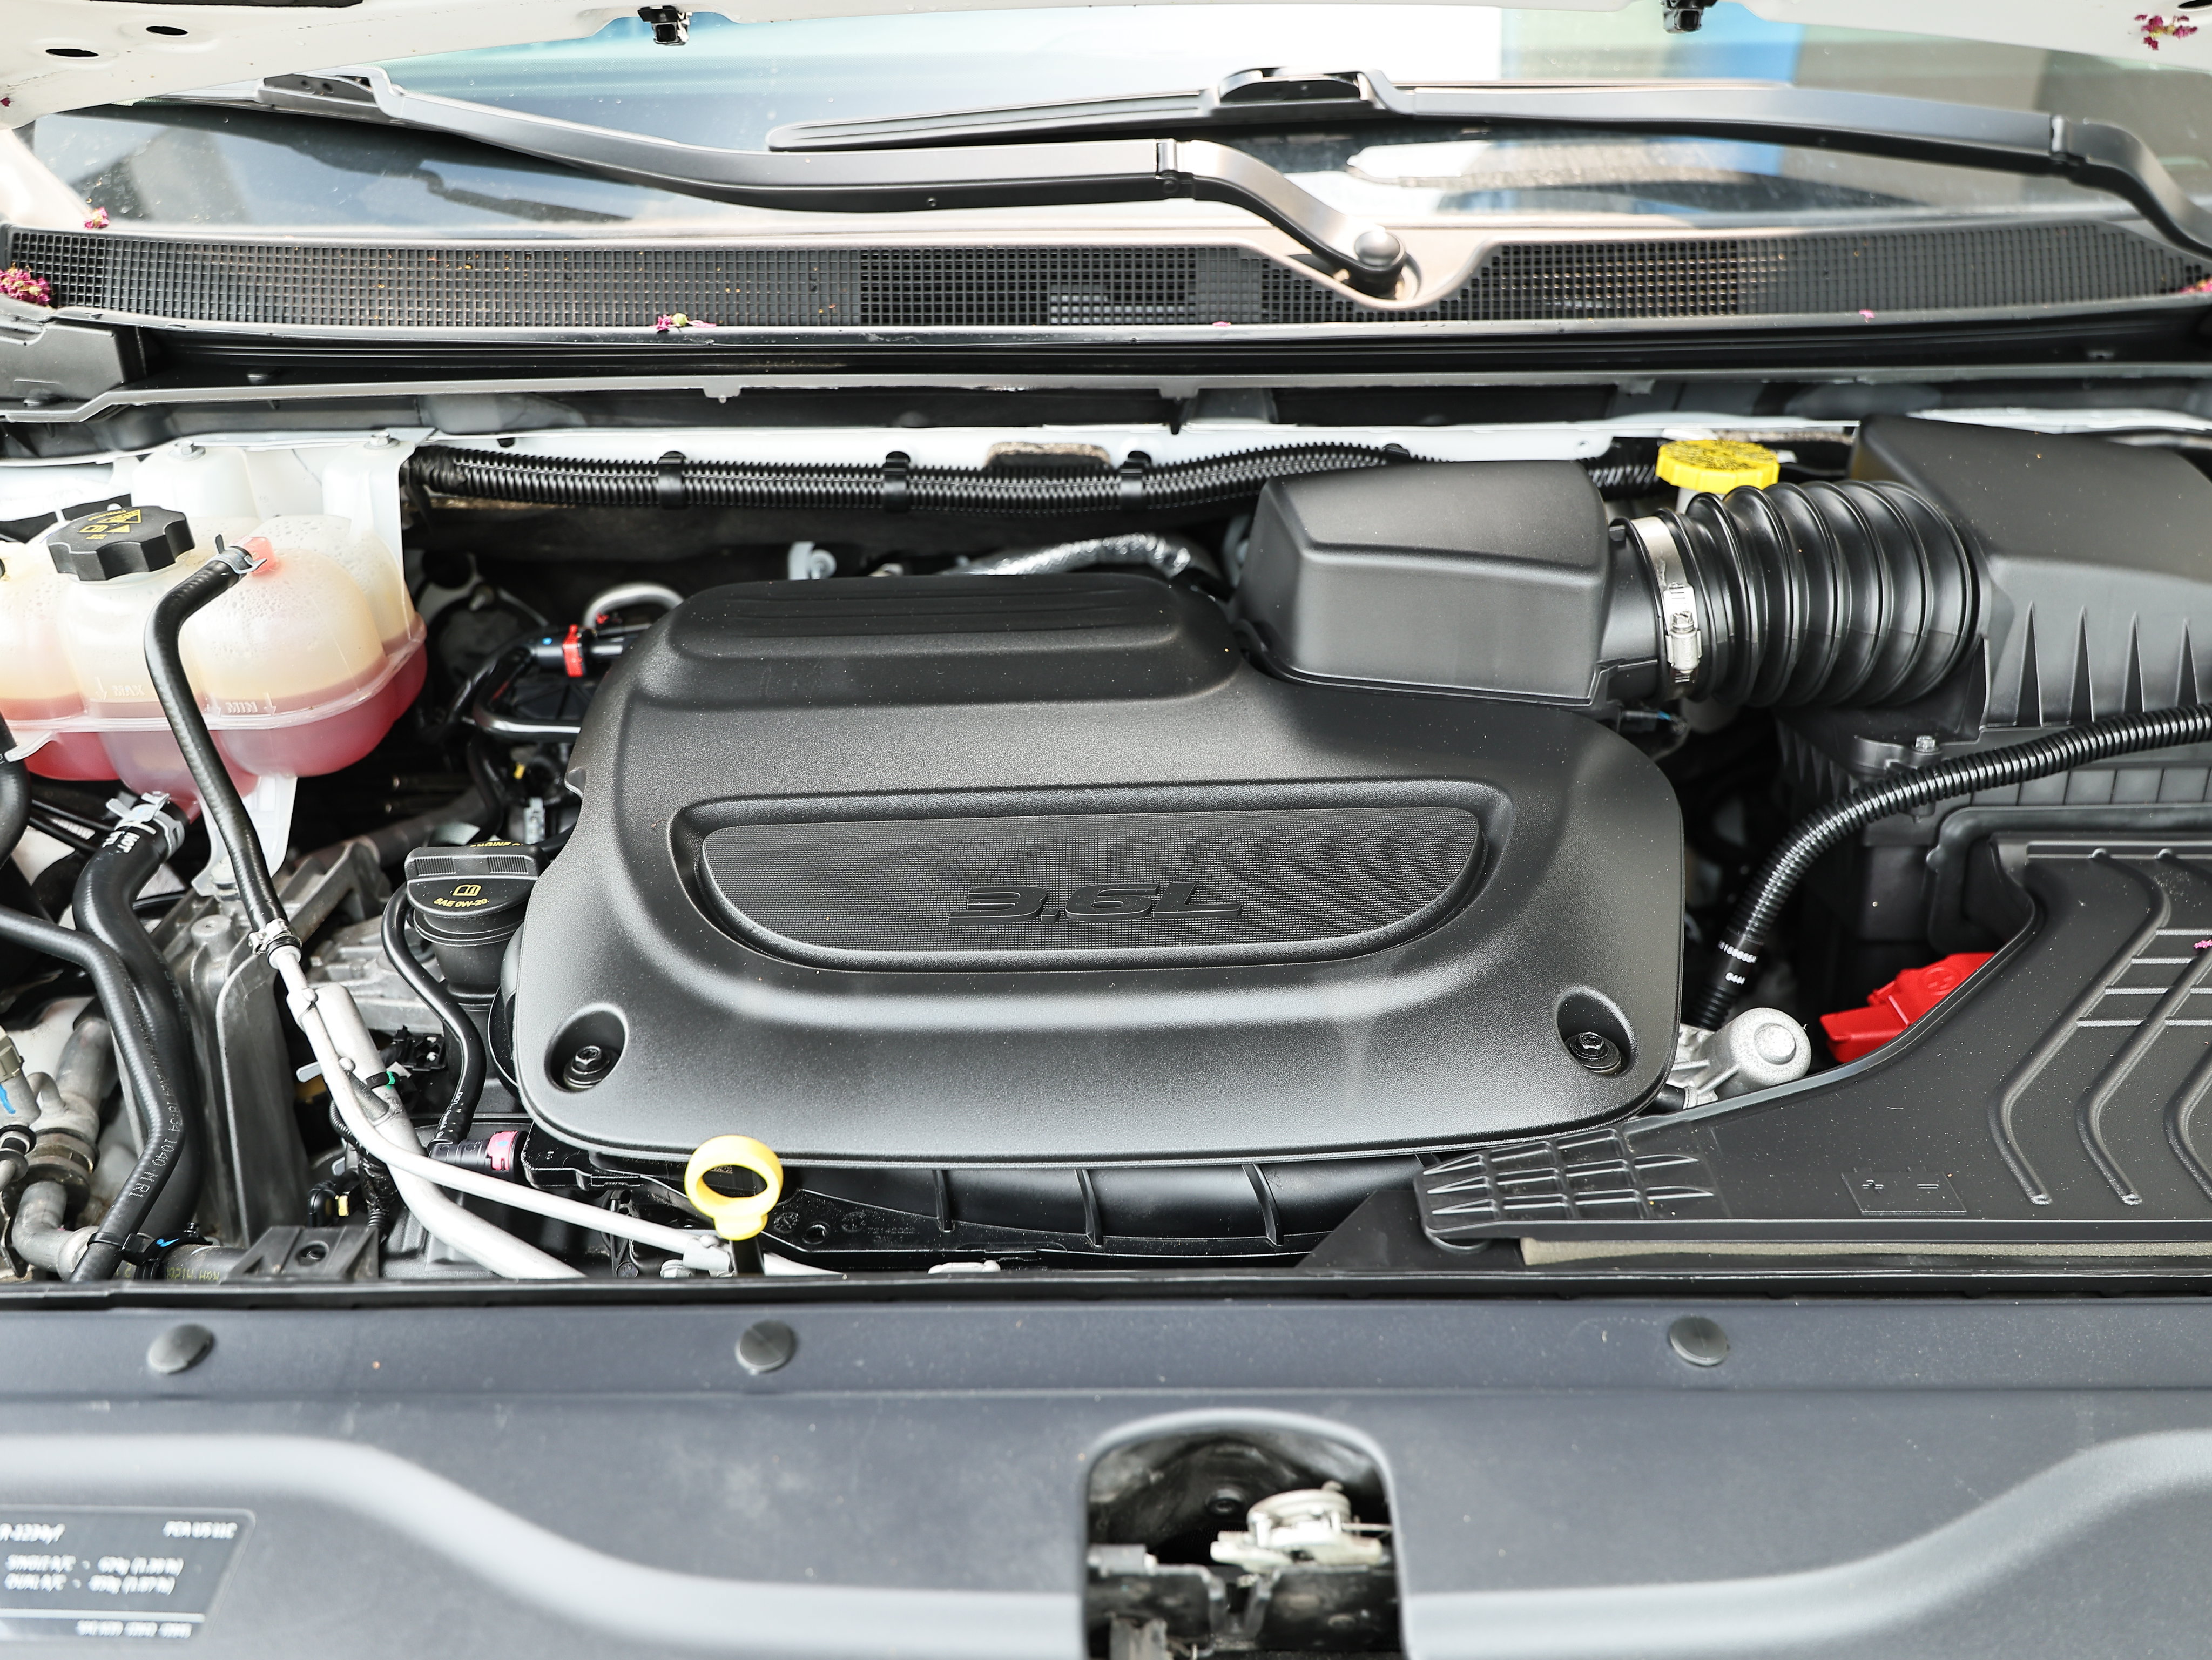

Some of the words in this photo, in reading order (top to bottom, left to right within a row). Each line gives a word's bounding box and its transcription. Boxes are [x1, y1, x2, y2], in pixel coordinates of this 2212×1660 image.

[112, 685, 145, 696] MAX
[225, 701, 258, 713] MIN
[434, 898, 455, 907] SAE
[455, 898, 488, 907] 0W-20
[949, 882, 1242, 924] 3.6L
